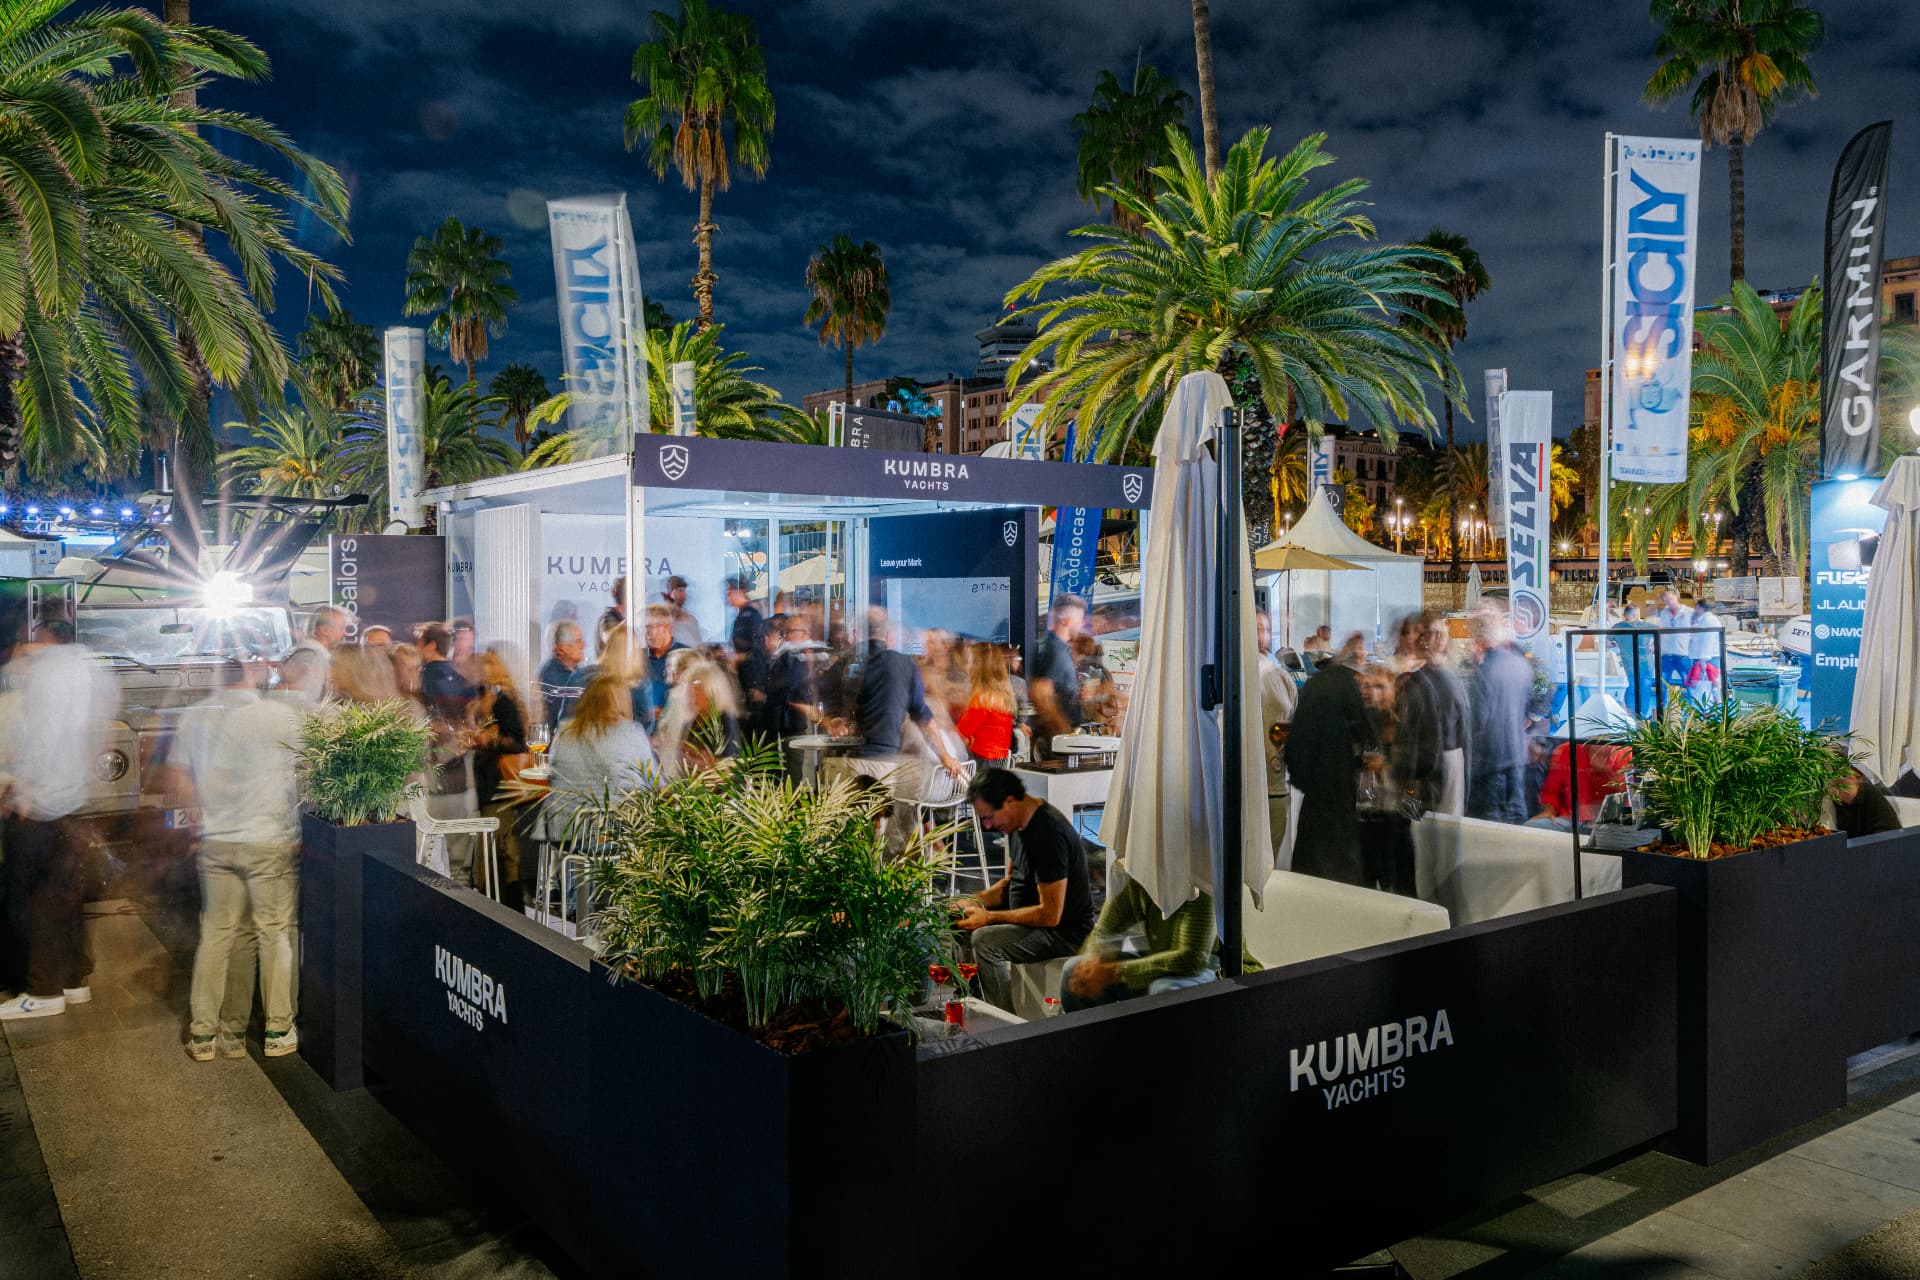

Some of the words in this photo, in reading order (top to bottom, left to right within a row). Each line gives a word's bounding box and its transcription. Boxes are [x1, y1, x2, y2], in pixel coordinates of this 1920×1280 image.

[1623, 167, 1687, 372] SICILY
[1839, 198, 1877, 437] GARMIN
[884, 459, 969, 479] KUMBRA
[904, 480, 949, 491] YACHTS
[1510, 442, 1537, 588] SELVA
[896, 560, 907, 568] your
[1816, 599, 1835, 610] JL
[435, 944, 508, 1024] KUMBRA
[447, 990, 484, 1031] YACHTS
[1289, 1008, 1455, 1092] KUMBRA
[1322, 1045, 1406, 1110] YACHTS
